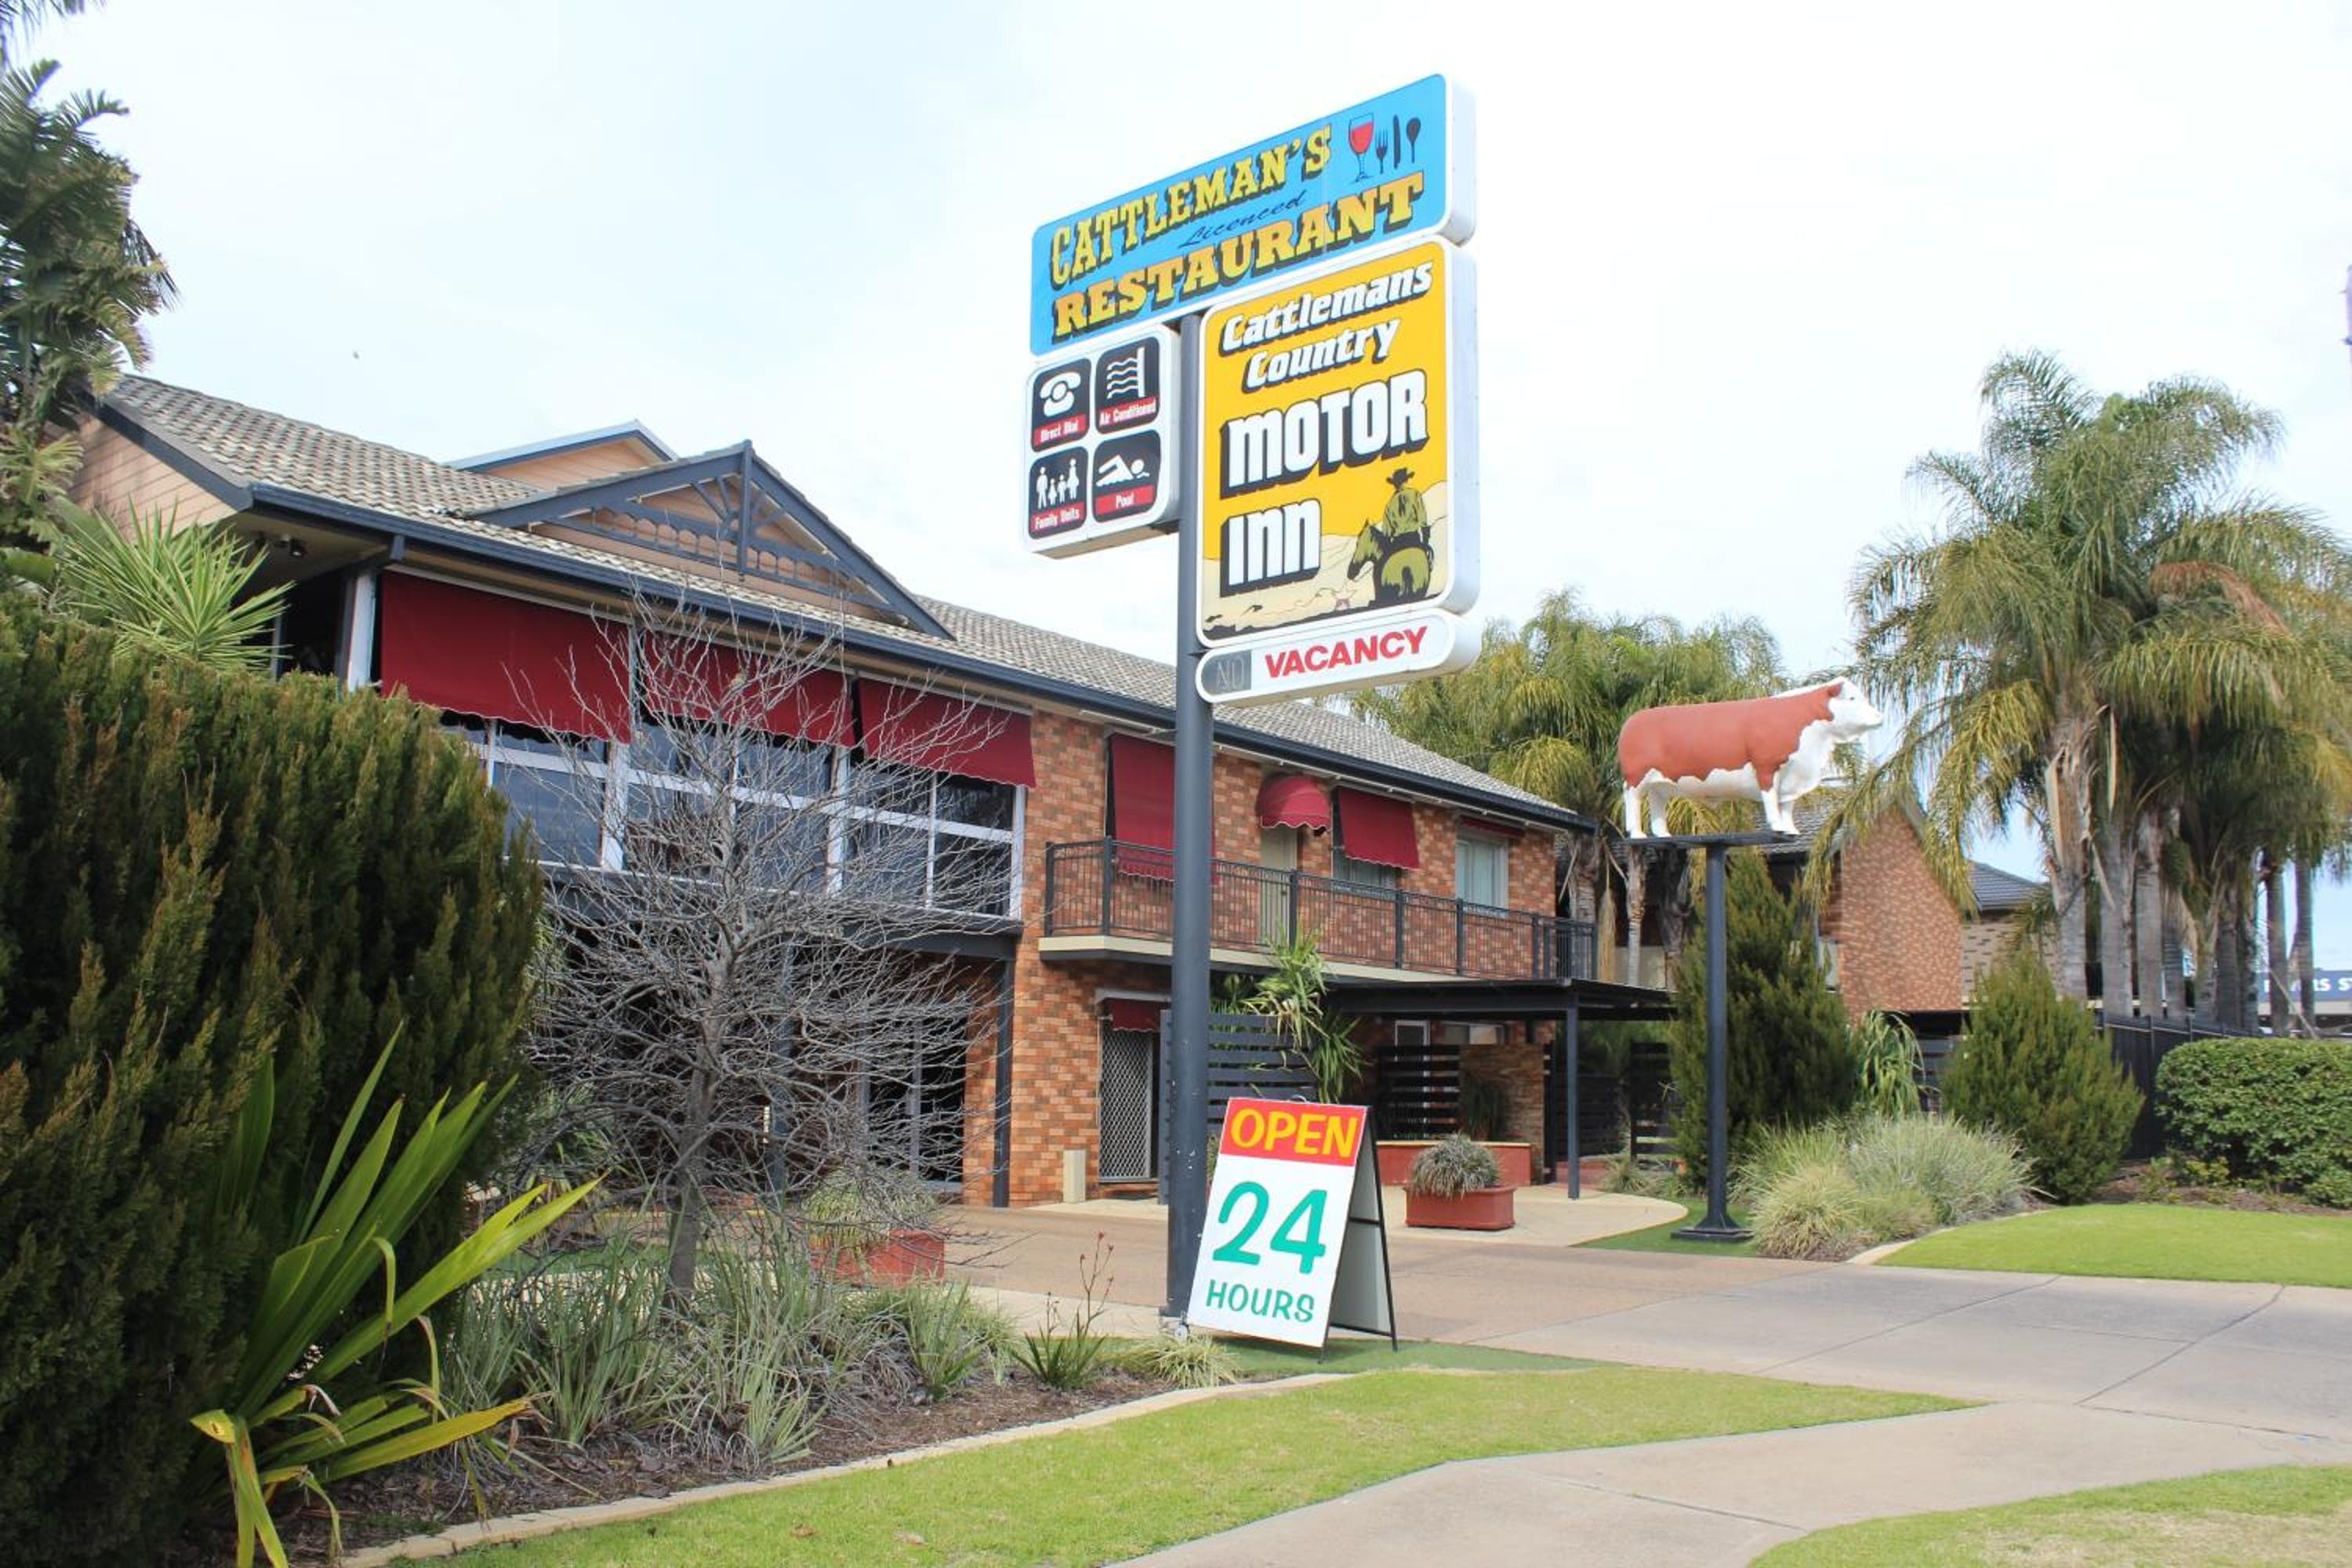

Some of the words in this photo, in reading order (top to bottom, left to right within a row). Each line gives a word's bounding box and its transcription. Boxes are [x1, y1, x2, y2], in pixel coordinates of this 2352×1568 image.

[1049, 123, 1333, 290] CATTLEMAN'S
[1178, 189, 1307, 249] Licenced
[1051, 170, 1425, 345] RESTAURANT
[1219, 263, 1434, 357] Cattlemans
[1242, 318, 1401, 393] Country
[1034, 514, 1058, 531] Family
[1116, 494, 1134, 510] Pool
[1265, 626, 1428, 679] VACANCY
[1229, 1108, 1359, 1158] OPEN
[1213, 1181, 1327, 1275] 24
[1206, 1279, 1315, 1323] HOURS
